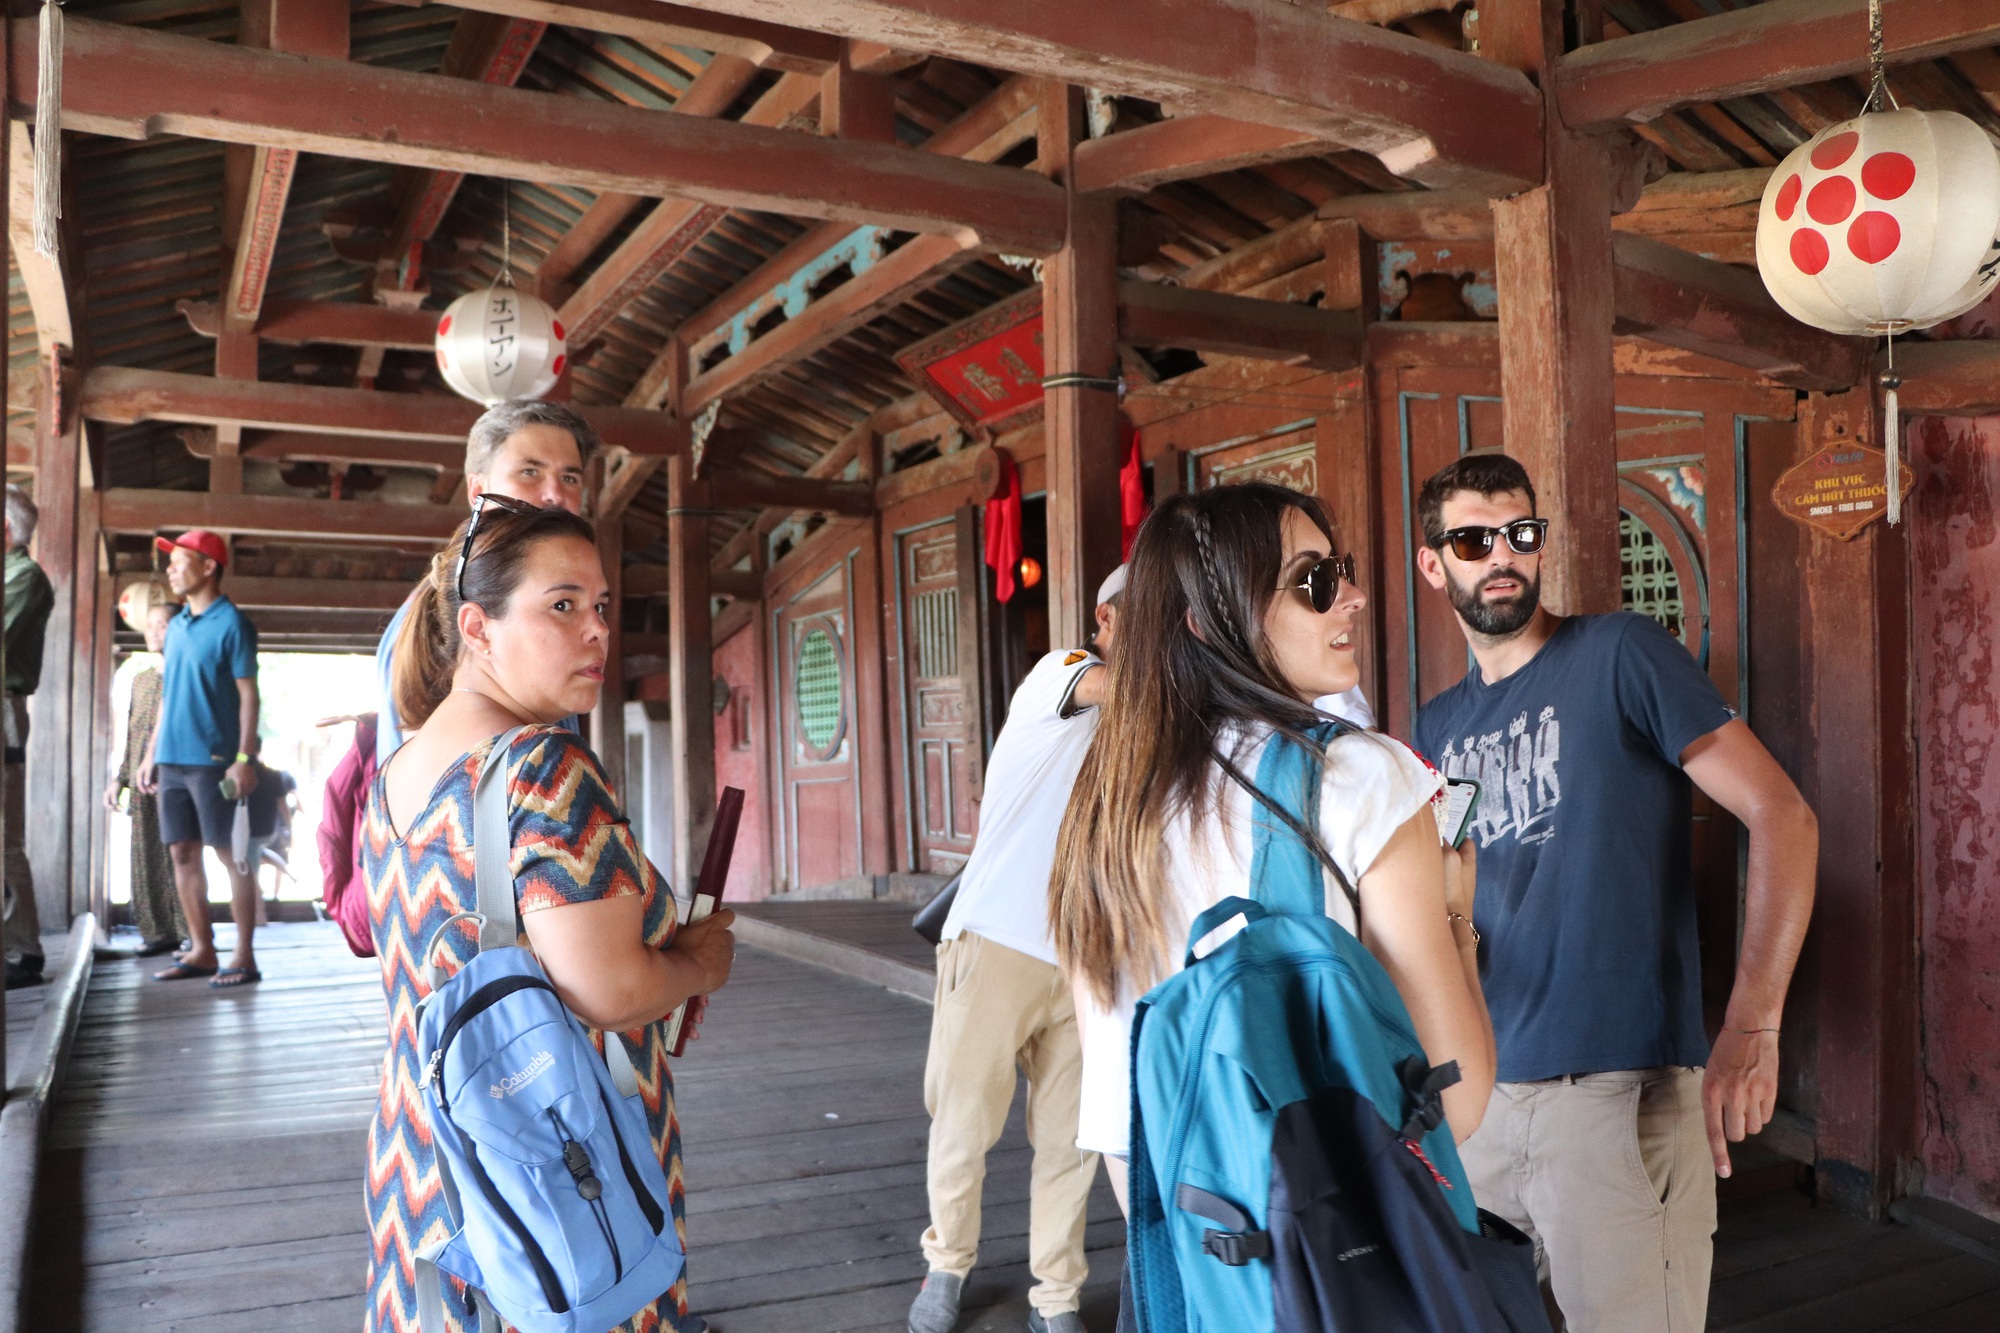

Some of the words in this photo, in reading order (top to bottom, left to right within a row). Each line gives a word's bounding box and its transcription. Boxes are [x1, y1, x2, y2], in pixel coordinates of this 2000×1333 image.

[1815, 477, 1839, 489] KHU
[1810, 505, 1833, 516] SMOKE
[1839, 502, 1854, 512] FREE
[1855, 500, 1873, 510] AREA
[500, 1050, 553, 1090] Columbia
